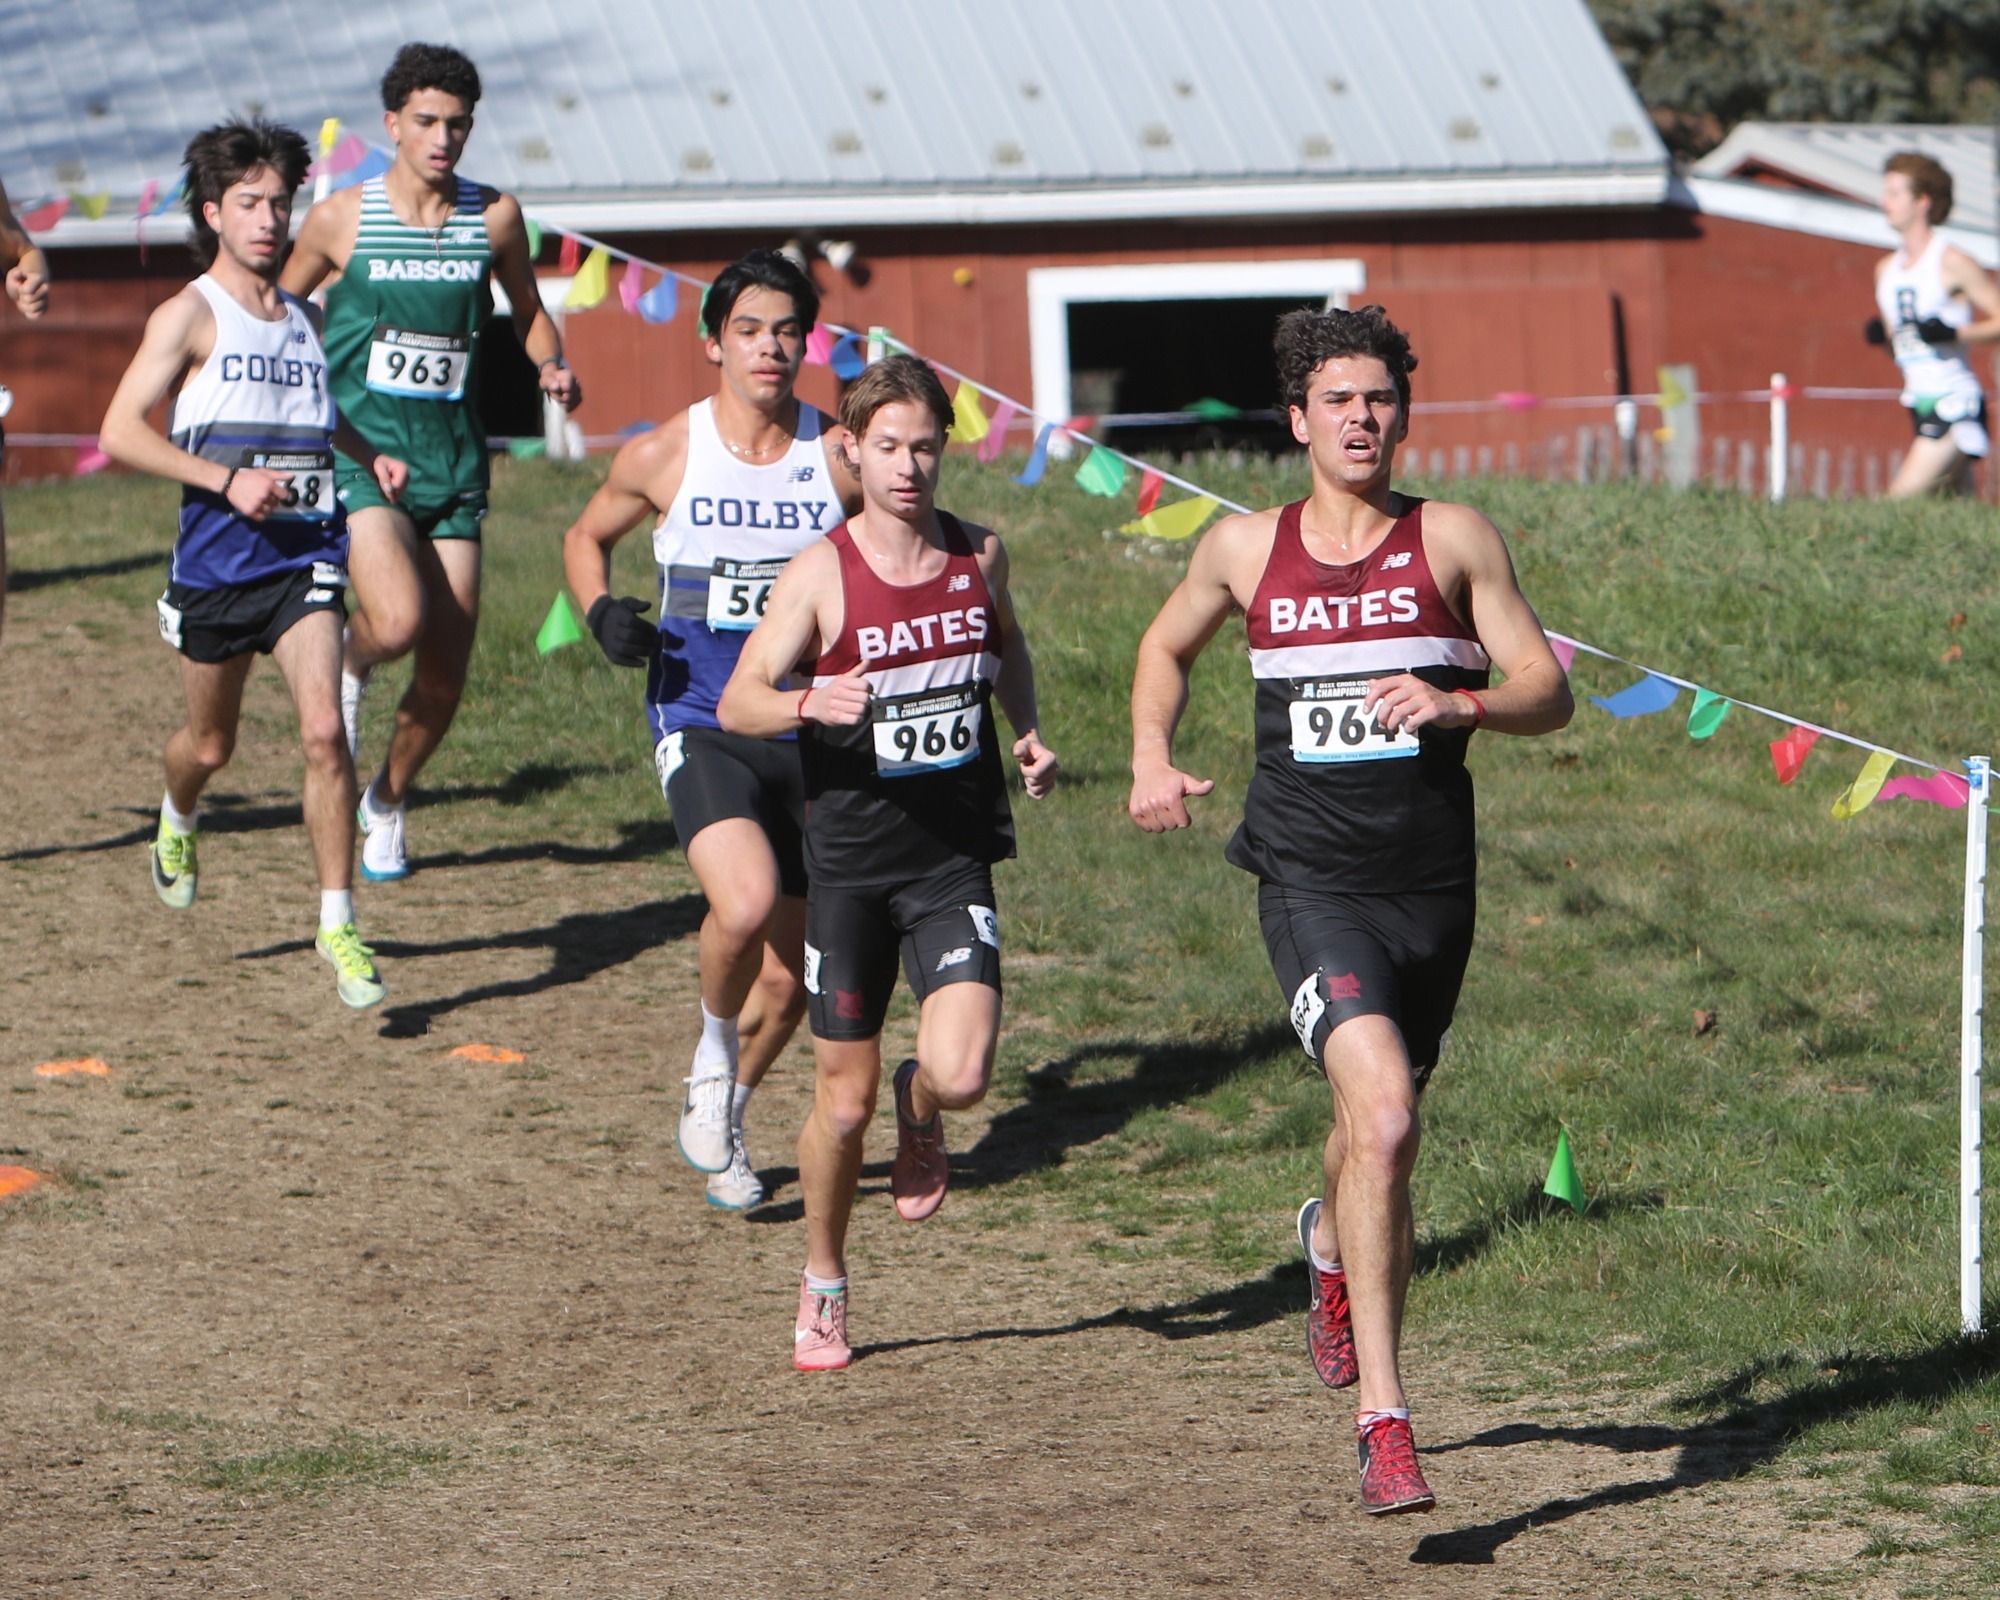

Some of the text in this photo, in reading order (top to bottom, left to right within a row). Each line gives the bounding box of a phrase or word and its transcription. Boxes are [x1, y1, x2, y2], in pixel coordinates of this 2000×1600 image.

[368, 258, 481, 282] BABSON
[221, 353, 323, 389] COLBY
[385, 349, 452, 386] 963
[280, 475, 320, 507] 68
[690, 497, 828, 530] COLBY
[727, 583, 772, 617] 56
[1270, 586, 1419, 634] BATES
[856, 606, 988, 661] BATES
[901, 698, 962, 718] CHAMPIONSHIPS
[1316, 686, 1370, 698] CHAMPIONS
[893, 714, 970, 762] 966
[1309, 704, 1399, 746] 964
